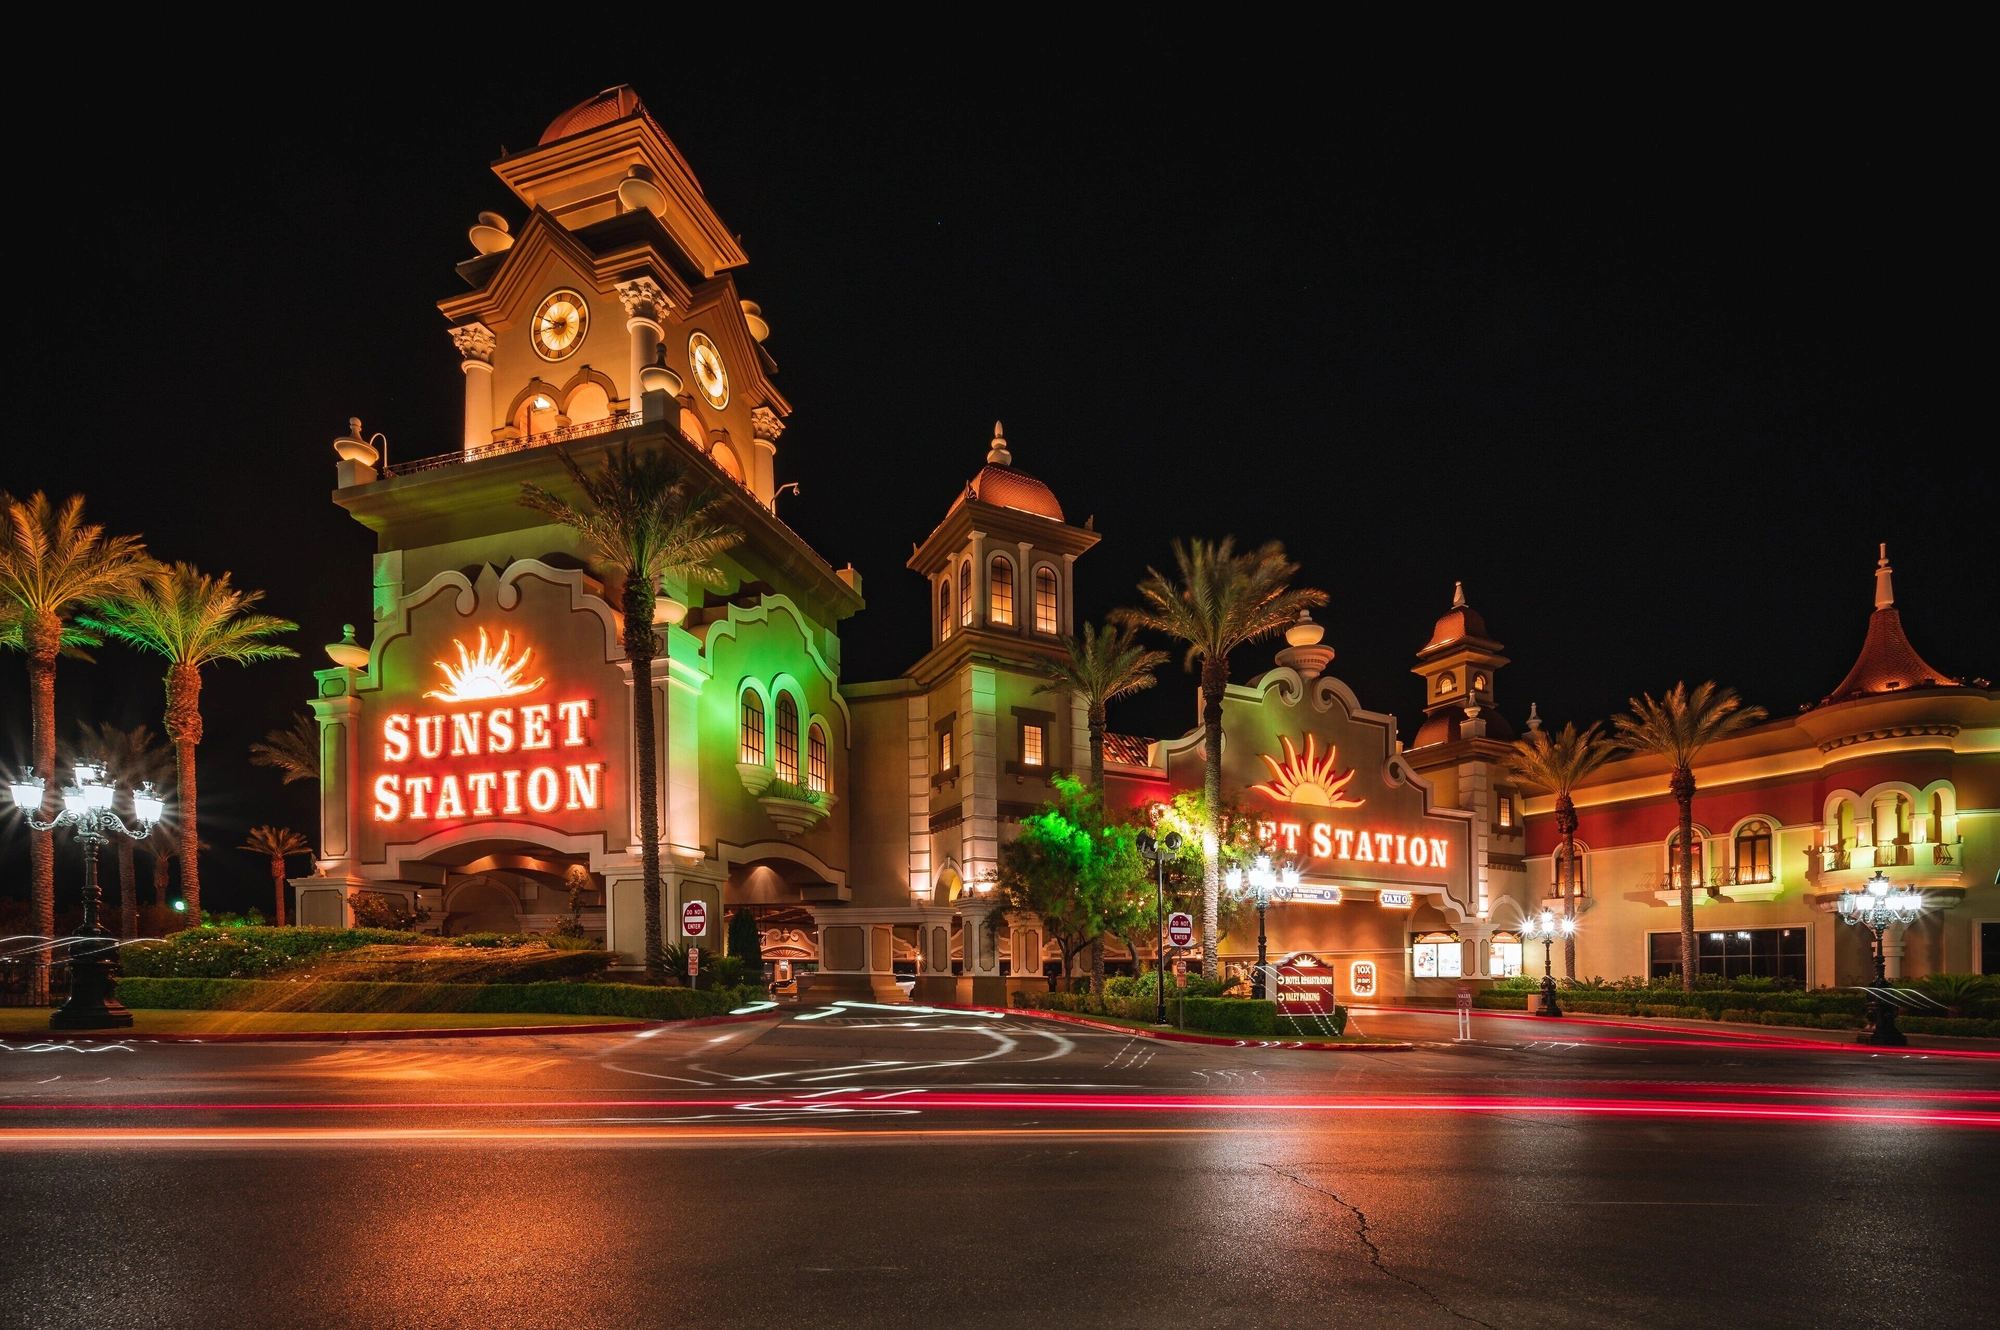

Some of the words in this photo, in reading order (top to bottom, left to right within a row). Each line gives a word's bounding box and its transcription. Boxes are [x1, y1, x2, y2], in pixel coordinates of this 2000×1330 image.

[383, 700, 590, 762] SUNSET
[374, 762, 602, 821] STATION
[1312, 822, 1449, 868] STATION
[1383, 894, 1401, 903] TAXI
[1357, 965, 1371, 974] 10X
[1285, 976, 1300, 985] HOTEL
[1300, 976, 1332, 985] REGISTRATION
[1285, 993, 1299, 1001] VALET
[1300, 993, 1320, 1001] PARKING
